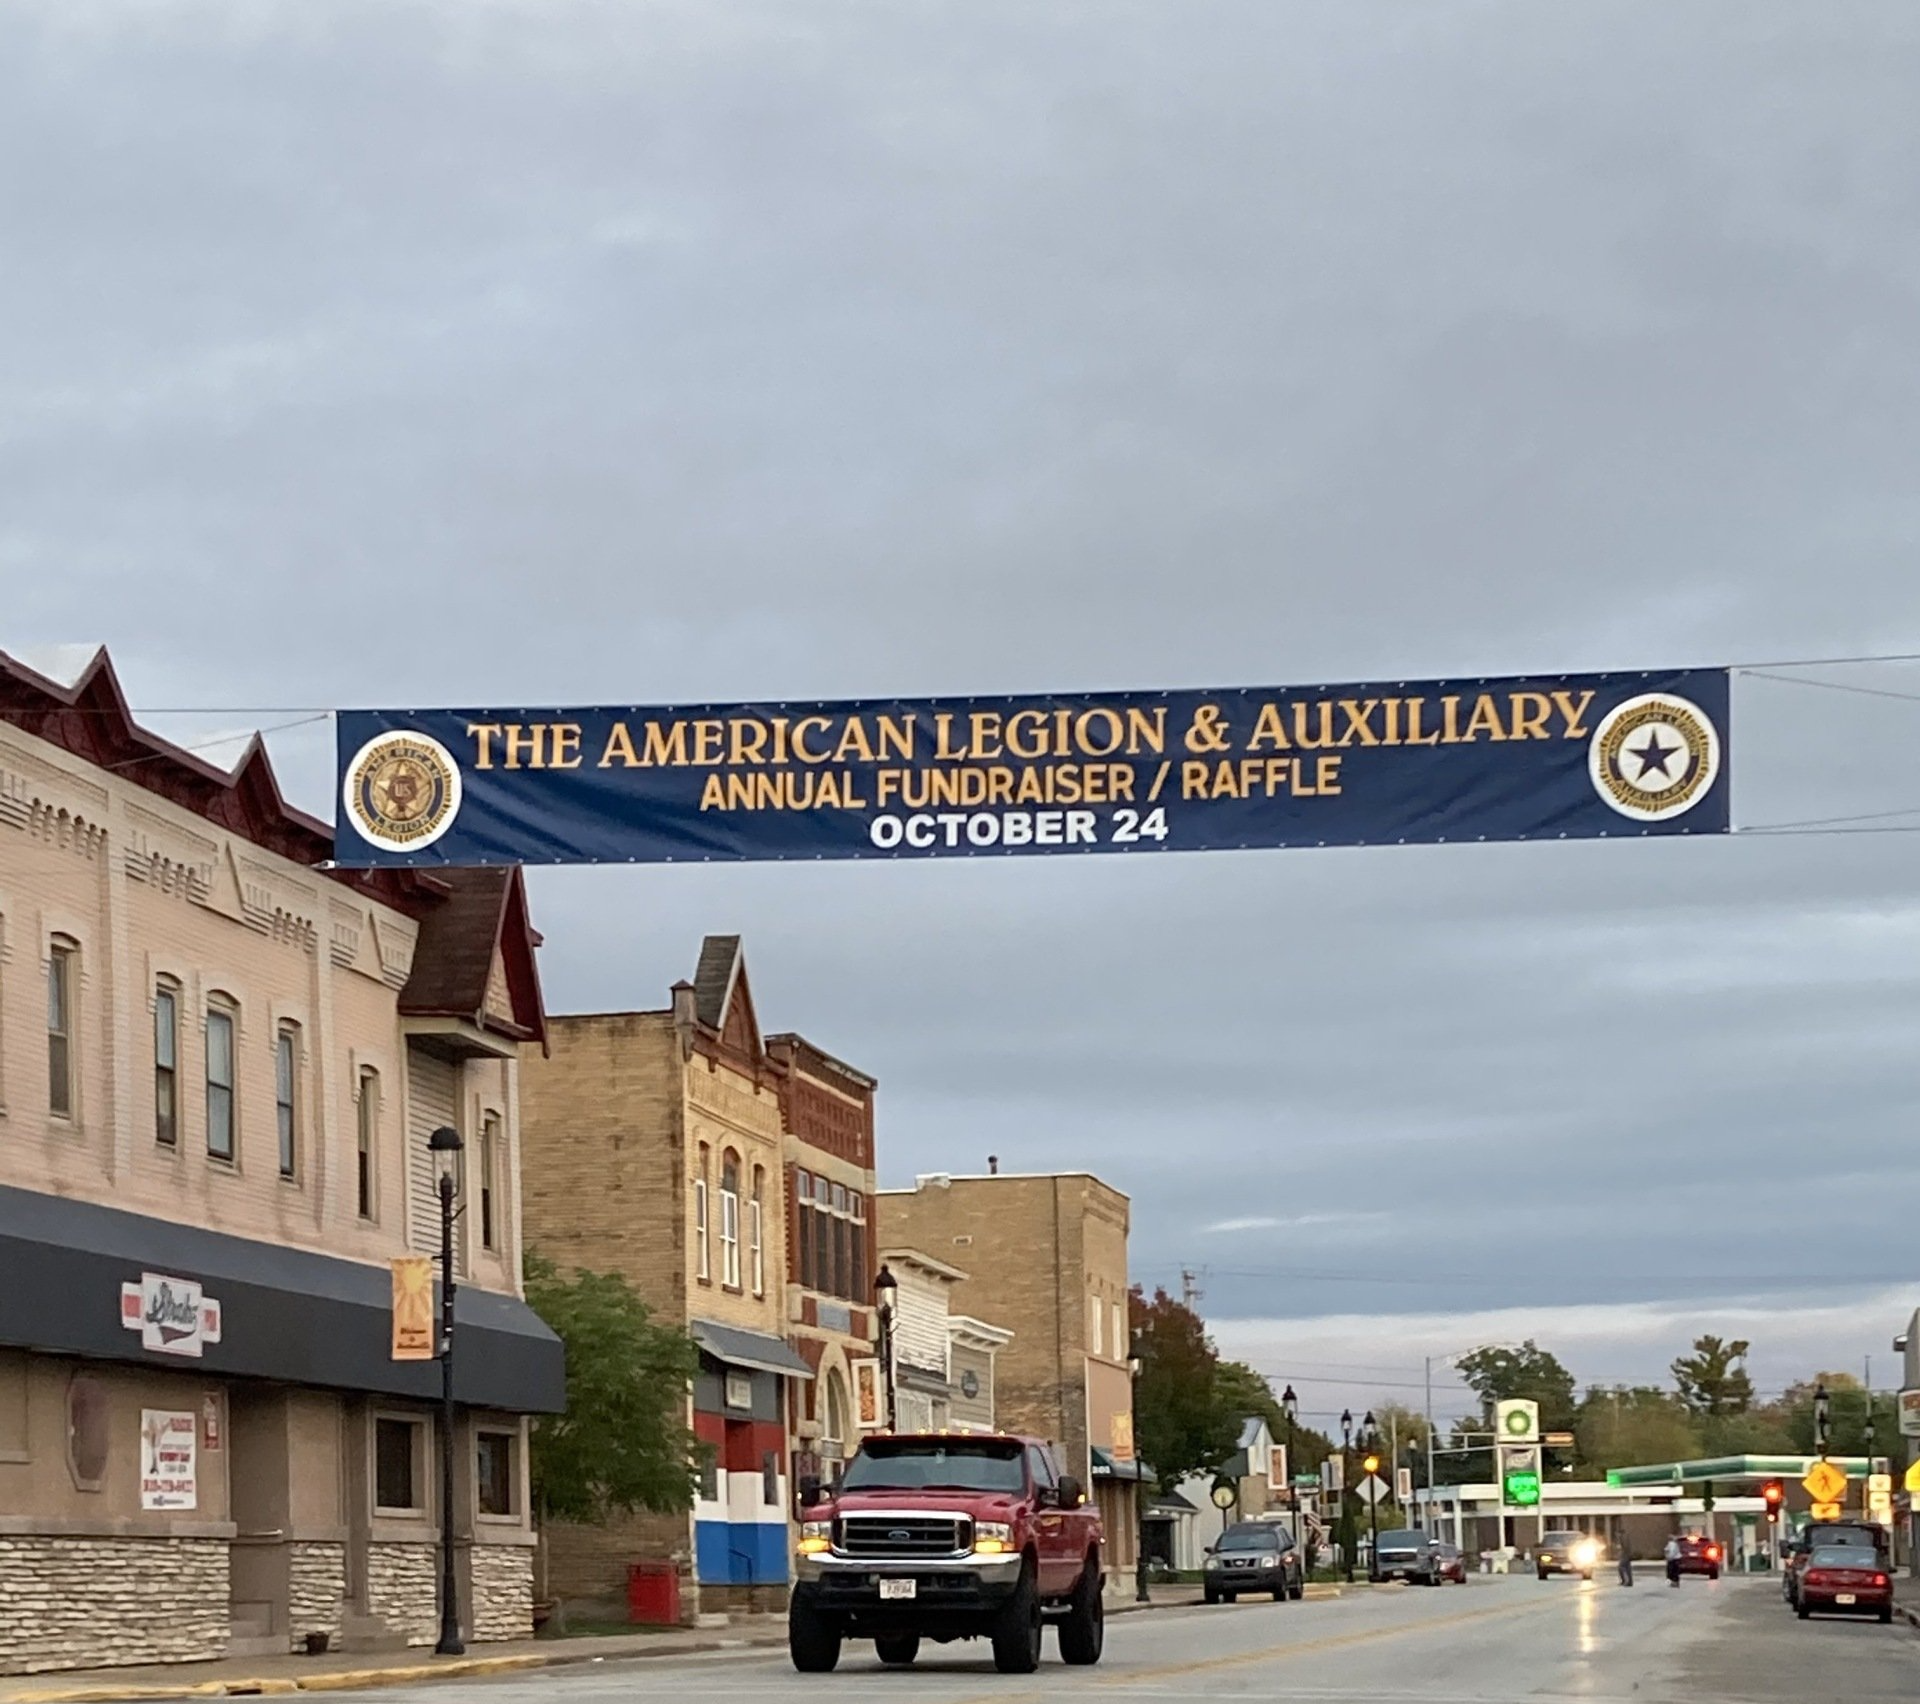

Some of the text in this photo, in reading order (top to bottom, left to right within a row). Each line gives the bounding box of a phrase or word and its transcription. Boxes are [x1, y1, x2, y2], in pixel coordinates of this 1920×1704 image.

[467, 690, 1596, 769] THE AMERICAN LEGION & AUXILIARY
[366, 747, 441, 780] AMERICAN
[700, 756, 1342, 812] ANNUAL FUNDRAISER / RAFFLE
[374, 814, 431, 834] LEGION
[870, 807, 1169, 848] OCTOBER 24
